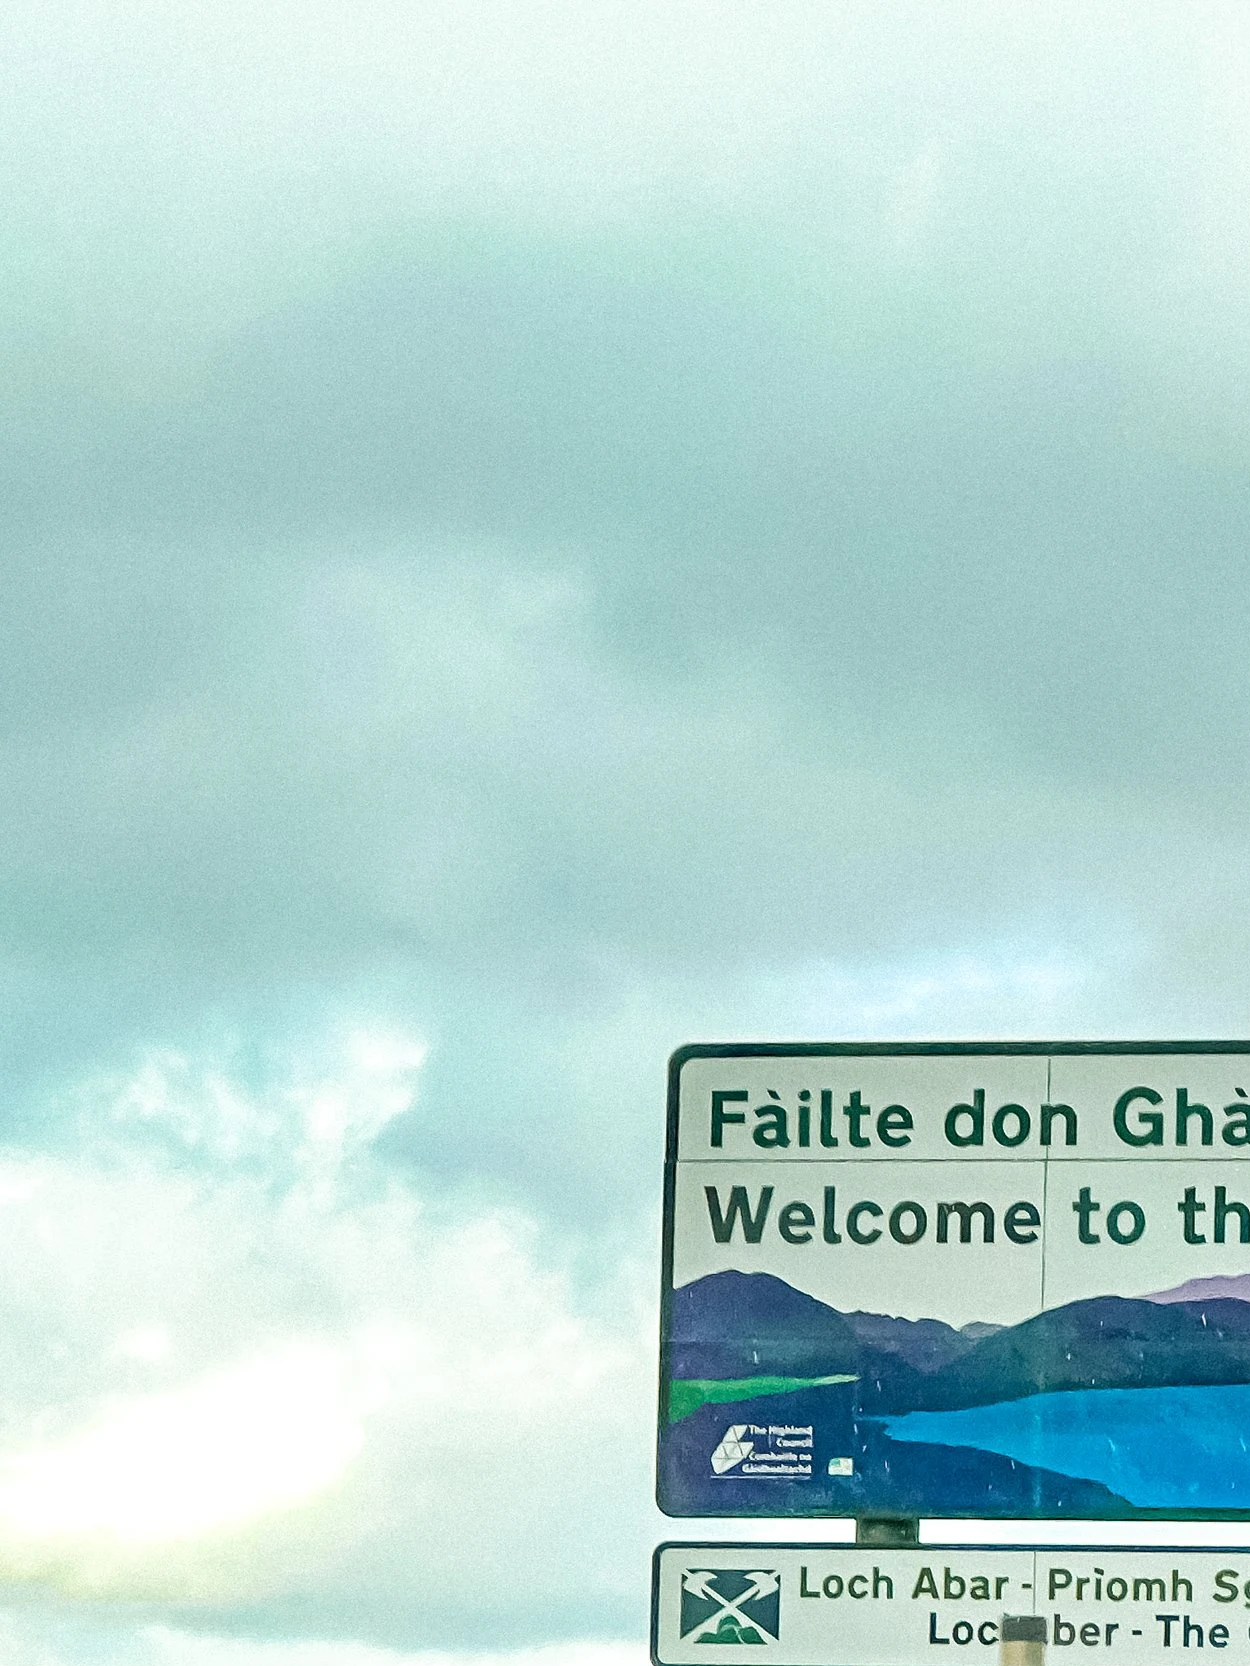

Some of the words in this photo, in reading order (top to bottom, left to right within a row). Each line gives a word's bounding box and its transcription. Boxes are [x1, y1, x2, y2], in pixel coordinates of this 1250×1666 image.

[710, 1088, 914, 1149] Fàilte
[944, 1089, 1078, 1147] don
[704, 1185, 1040, 1246] Welcome
[1072, 1186, 1146, 1246] to
[800, 1566, 893, 1599] Loch
[911, 1566, 1009, 1600] Abar
[1049, 1567, 1192, 1602] Prìomh
[929, 1612, 1119, 1648] Locber
[1155, 1615, 1230, 1648] The
